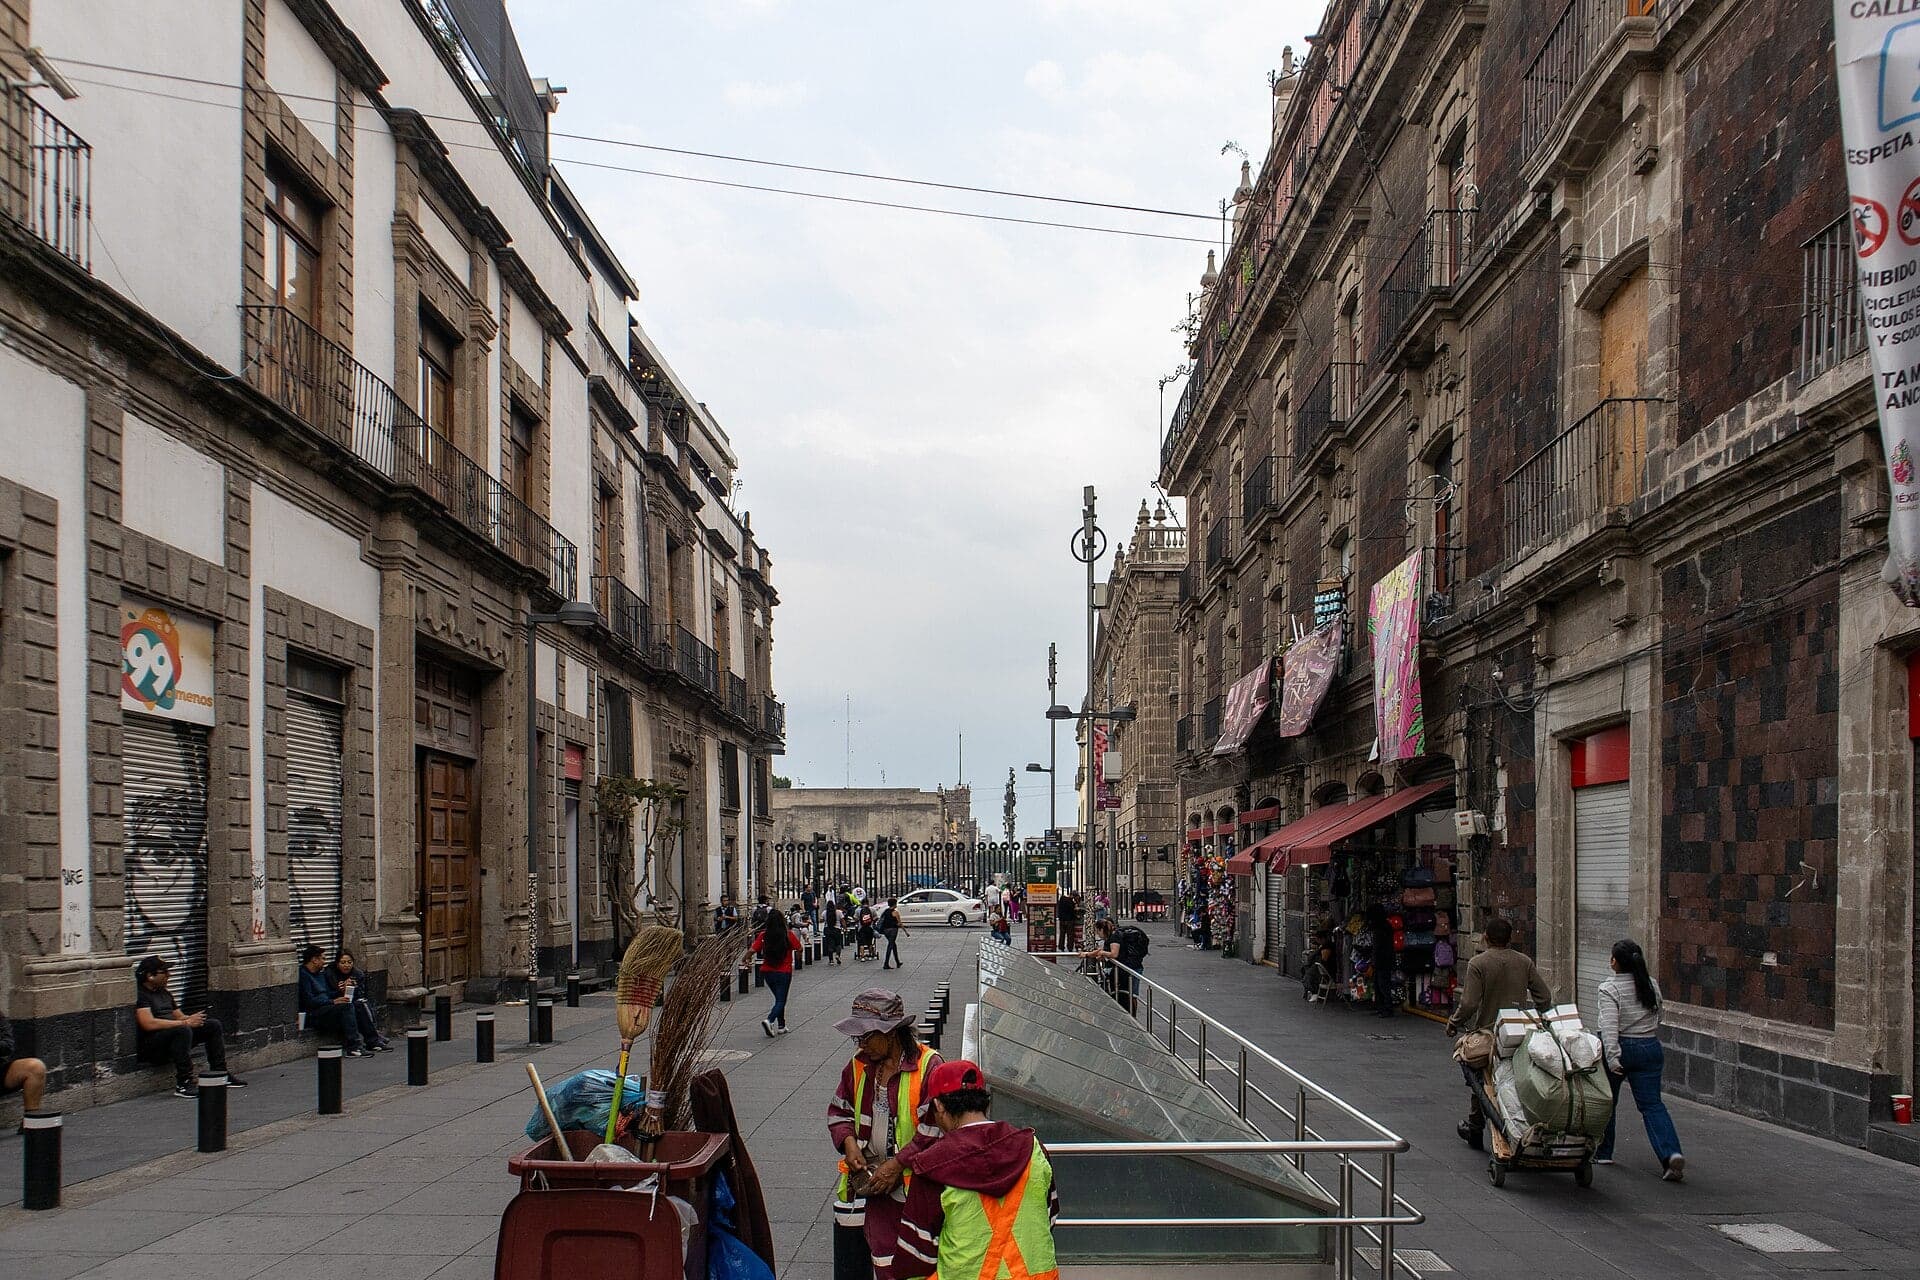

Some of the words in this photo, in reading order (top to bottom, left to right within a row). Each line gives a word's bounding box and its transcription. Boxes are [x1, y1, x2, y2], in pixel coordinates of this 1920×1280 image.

[1877, 335, 1888, 347] Y
[126, 633, 173, 696] 99
[175, 690, 214, 708] menos
